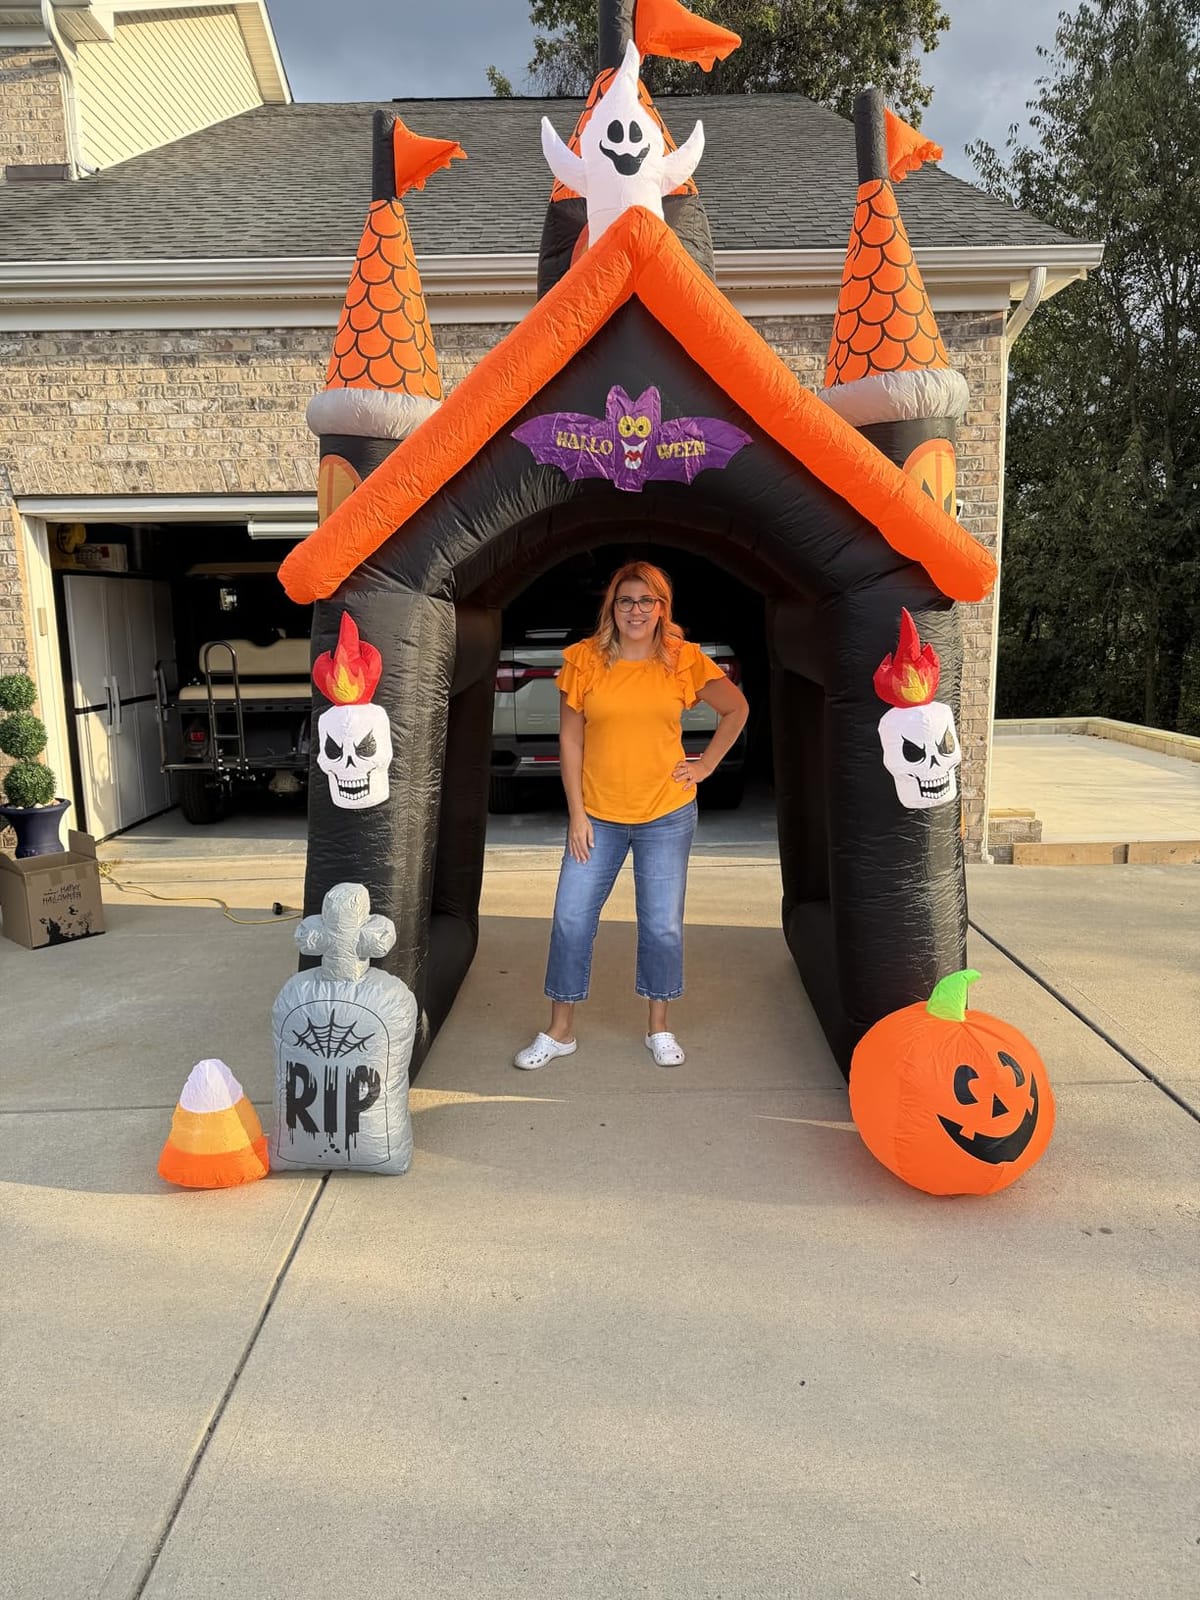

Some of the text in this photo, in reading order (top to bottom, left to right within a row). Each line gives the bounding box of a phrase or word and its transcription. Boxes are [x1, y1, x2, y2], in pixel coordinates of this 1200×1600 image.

[556, 431, 706, 460] HALLO WEEN
[286, 1061, 381, 1157] RIP
